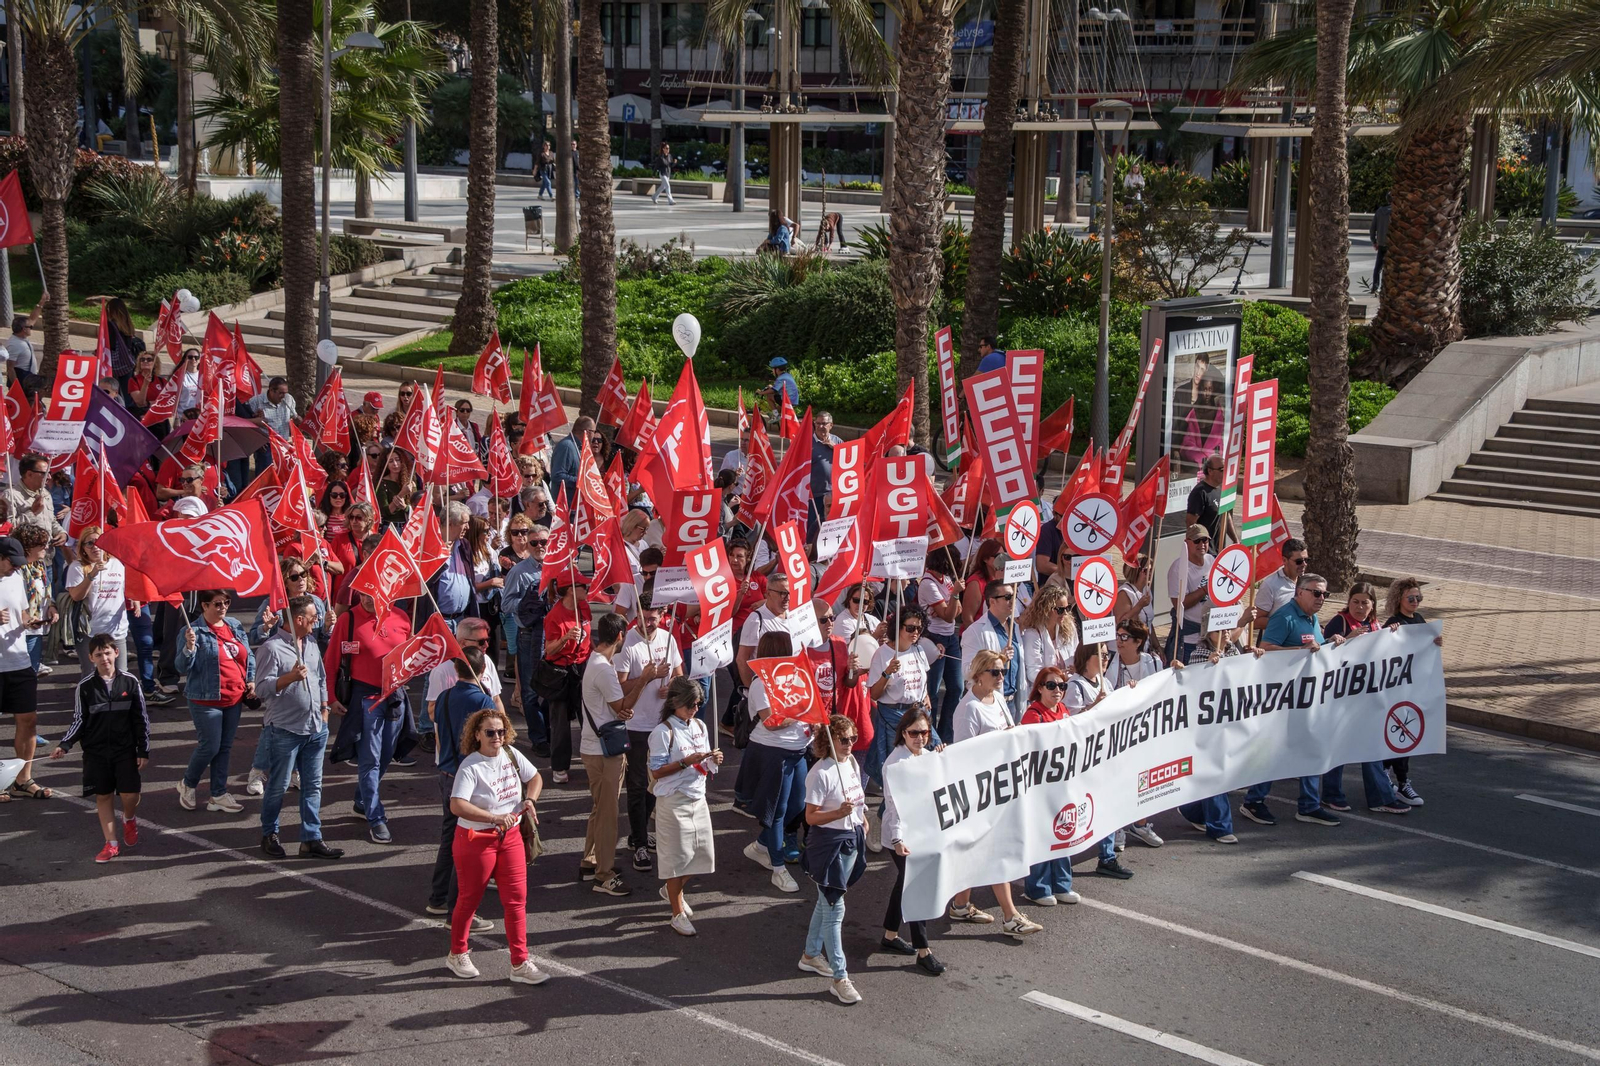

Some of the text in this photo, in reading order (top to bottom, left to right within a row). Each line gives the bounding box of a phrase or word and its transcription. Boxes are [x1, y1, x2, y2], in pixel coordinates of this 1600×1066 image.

[626, 107, 633, 119] P
[1176, 329, 1229, 350] VALENTINO
[58, 360, 90, 420] UGT
[938, 332, 958, 444] CCOO
[1225, 362, 1250, 486] CCOO
[972, 376, 1030, 503] CCOO
[1249, 387, 1273, 517] CCOO
[838, 445, 859, 518] UGT
[887, 461, 918, 538] UGT
[694, 546, 730, 629] UGT
[780, 526, 808, 606] UGT
[1098, 621, 1114, 629] BLANCA
[933, 653, 1414, 831] EN DEFENSA DE NUESTRA SANIDAD PÚBLICA
[1150, 763, 1179, 784] CCOO
[1160, 781, 1174, 790] sanidad
